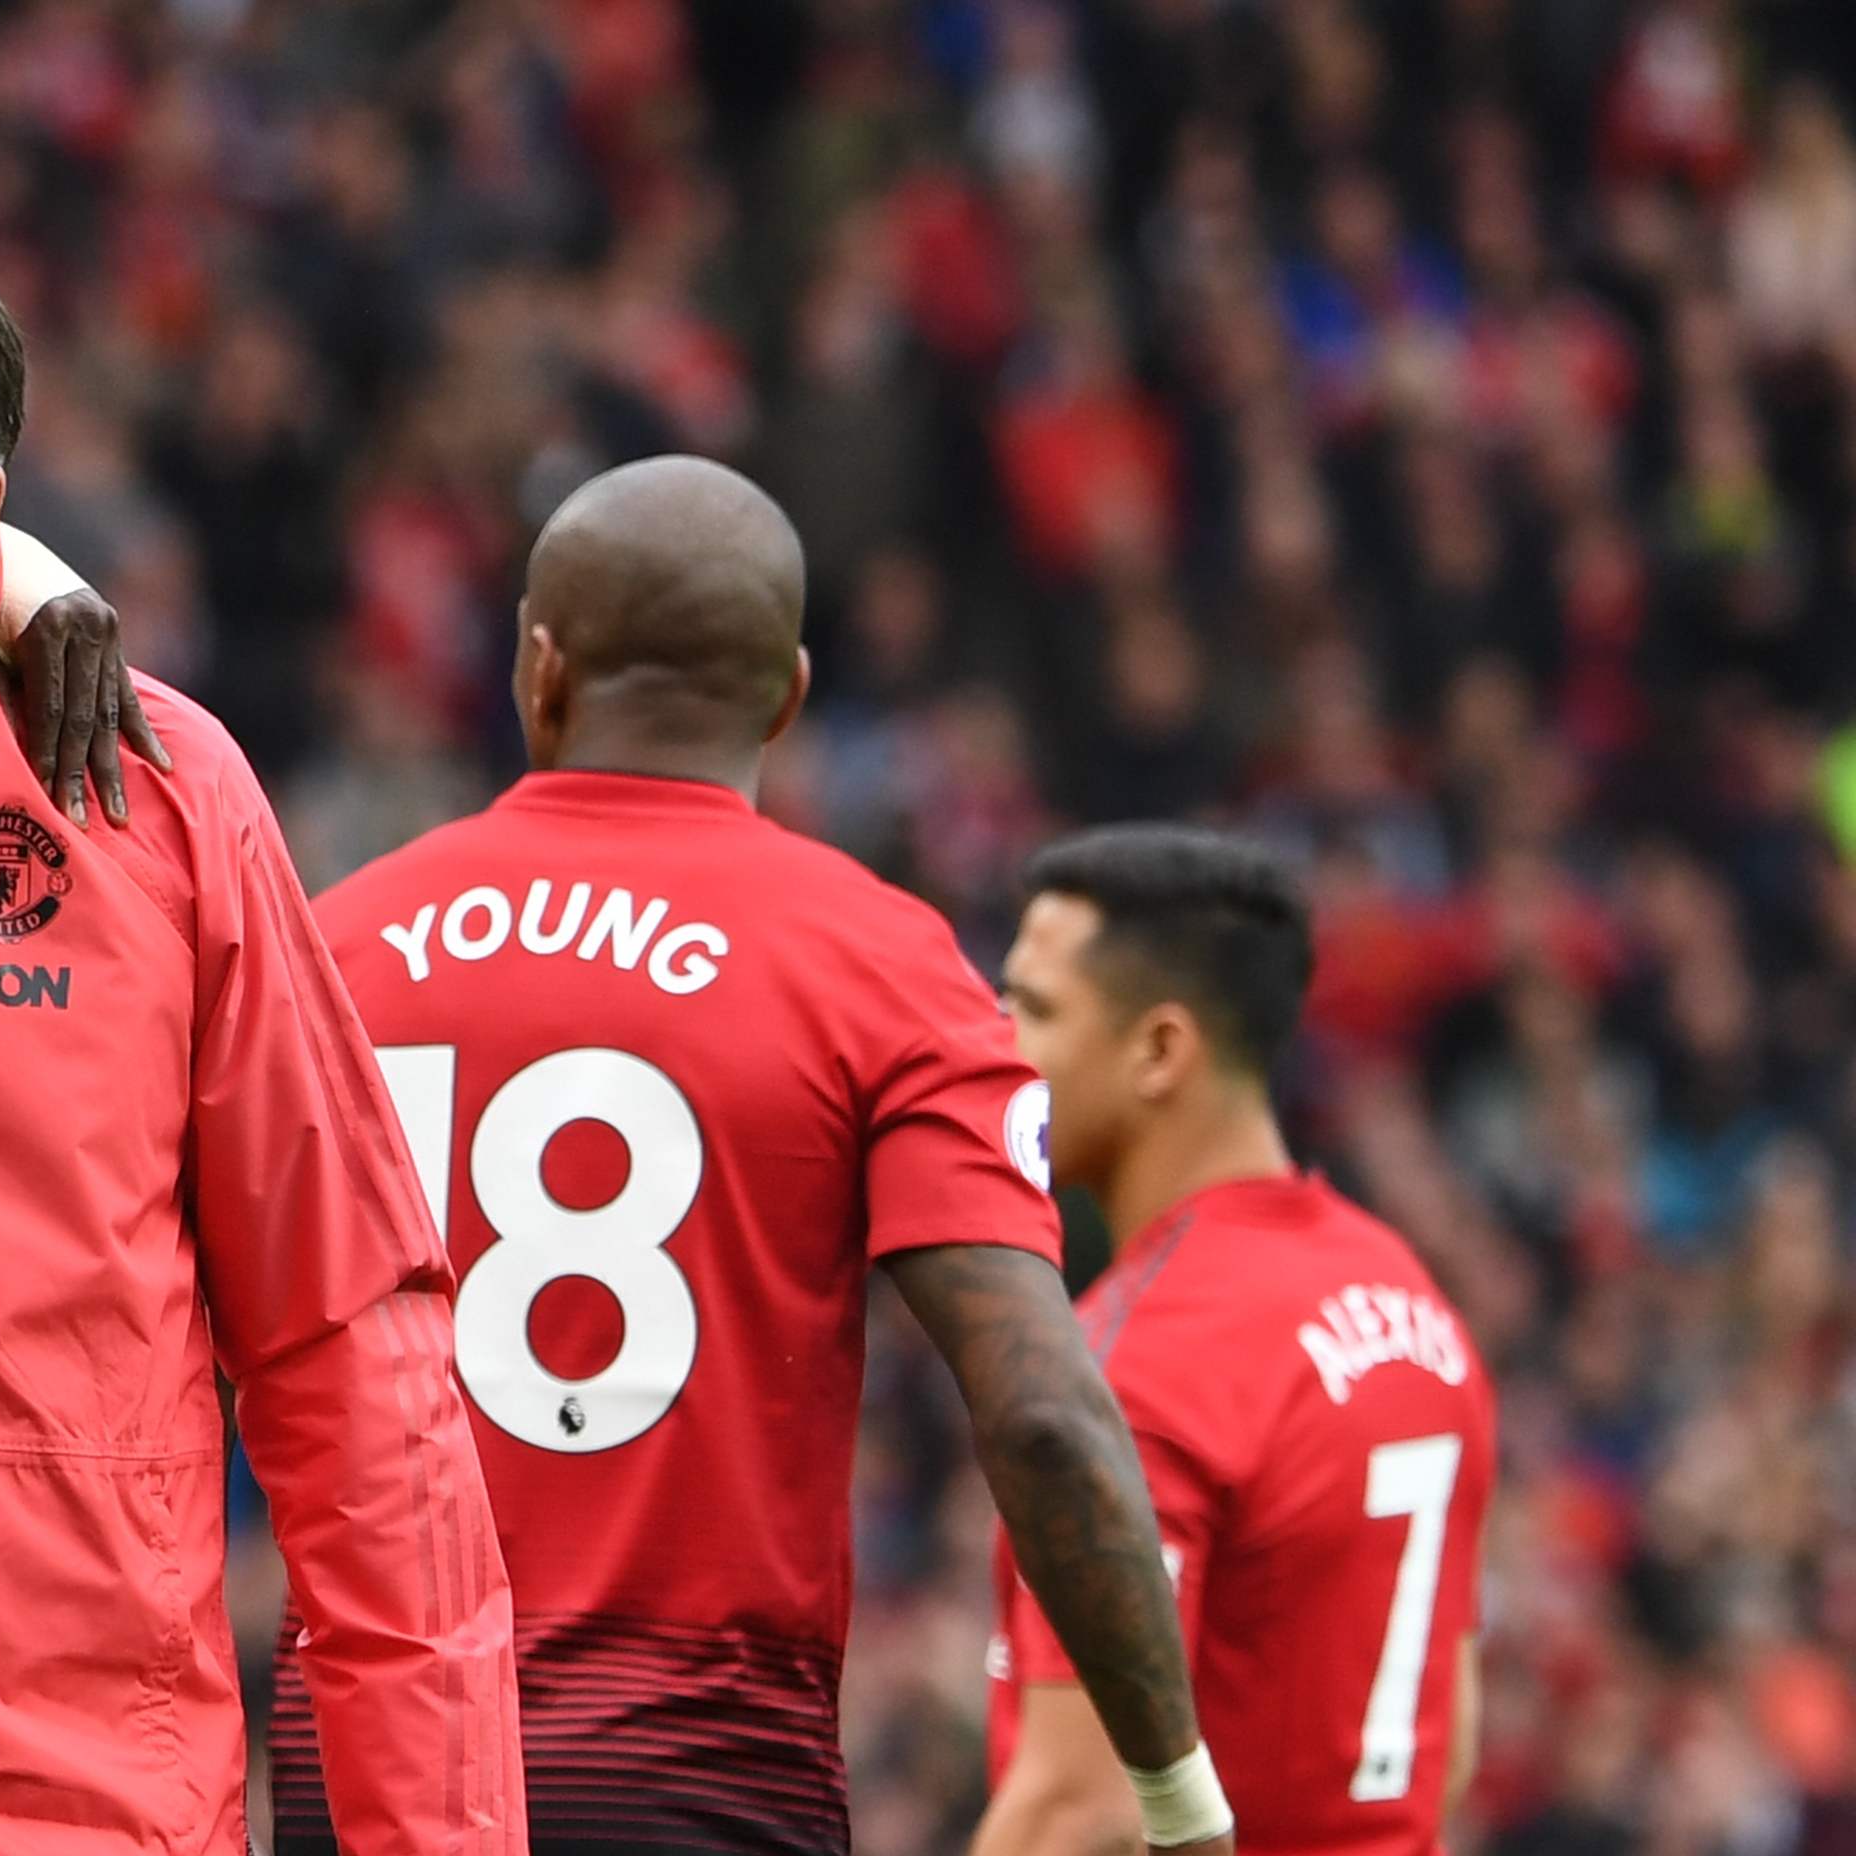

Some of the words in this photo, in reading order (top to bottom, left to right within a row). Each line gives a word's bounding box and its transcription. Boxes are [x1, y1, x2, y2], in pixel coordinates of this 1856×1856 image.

[380, 878, 730, 995] YOUNG
[373, 1044, 703, 1453] 8
[1349, 1433, 1463, 1803] 7
